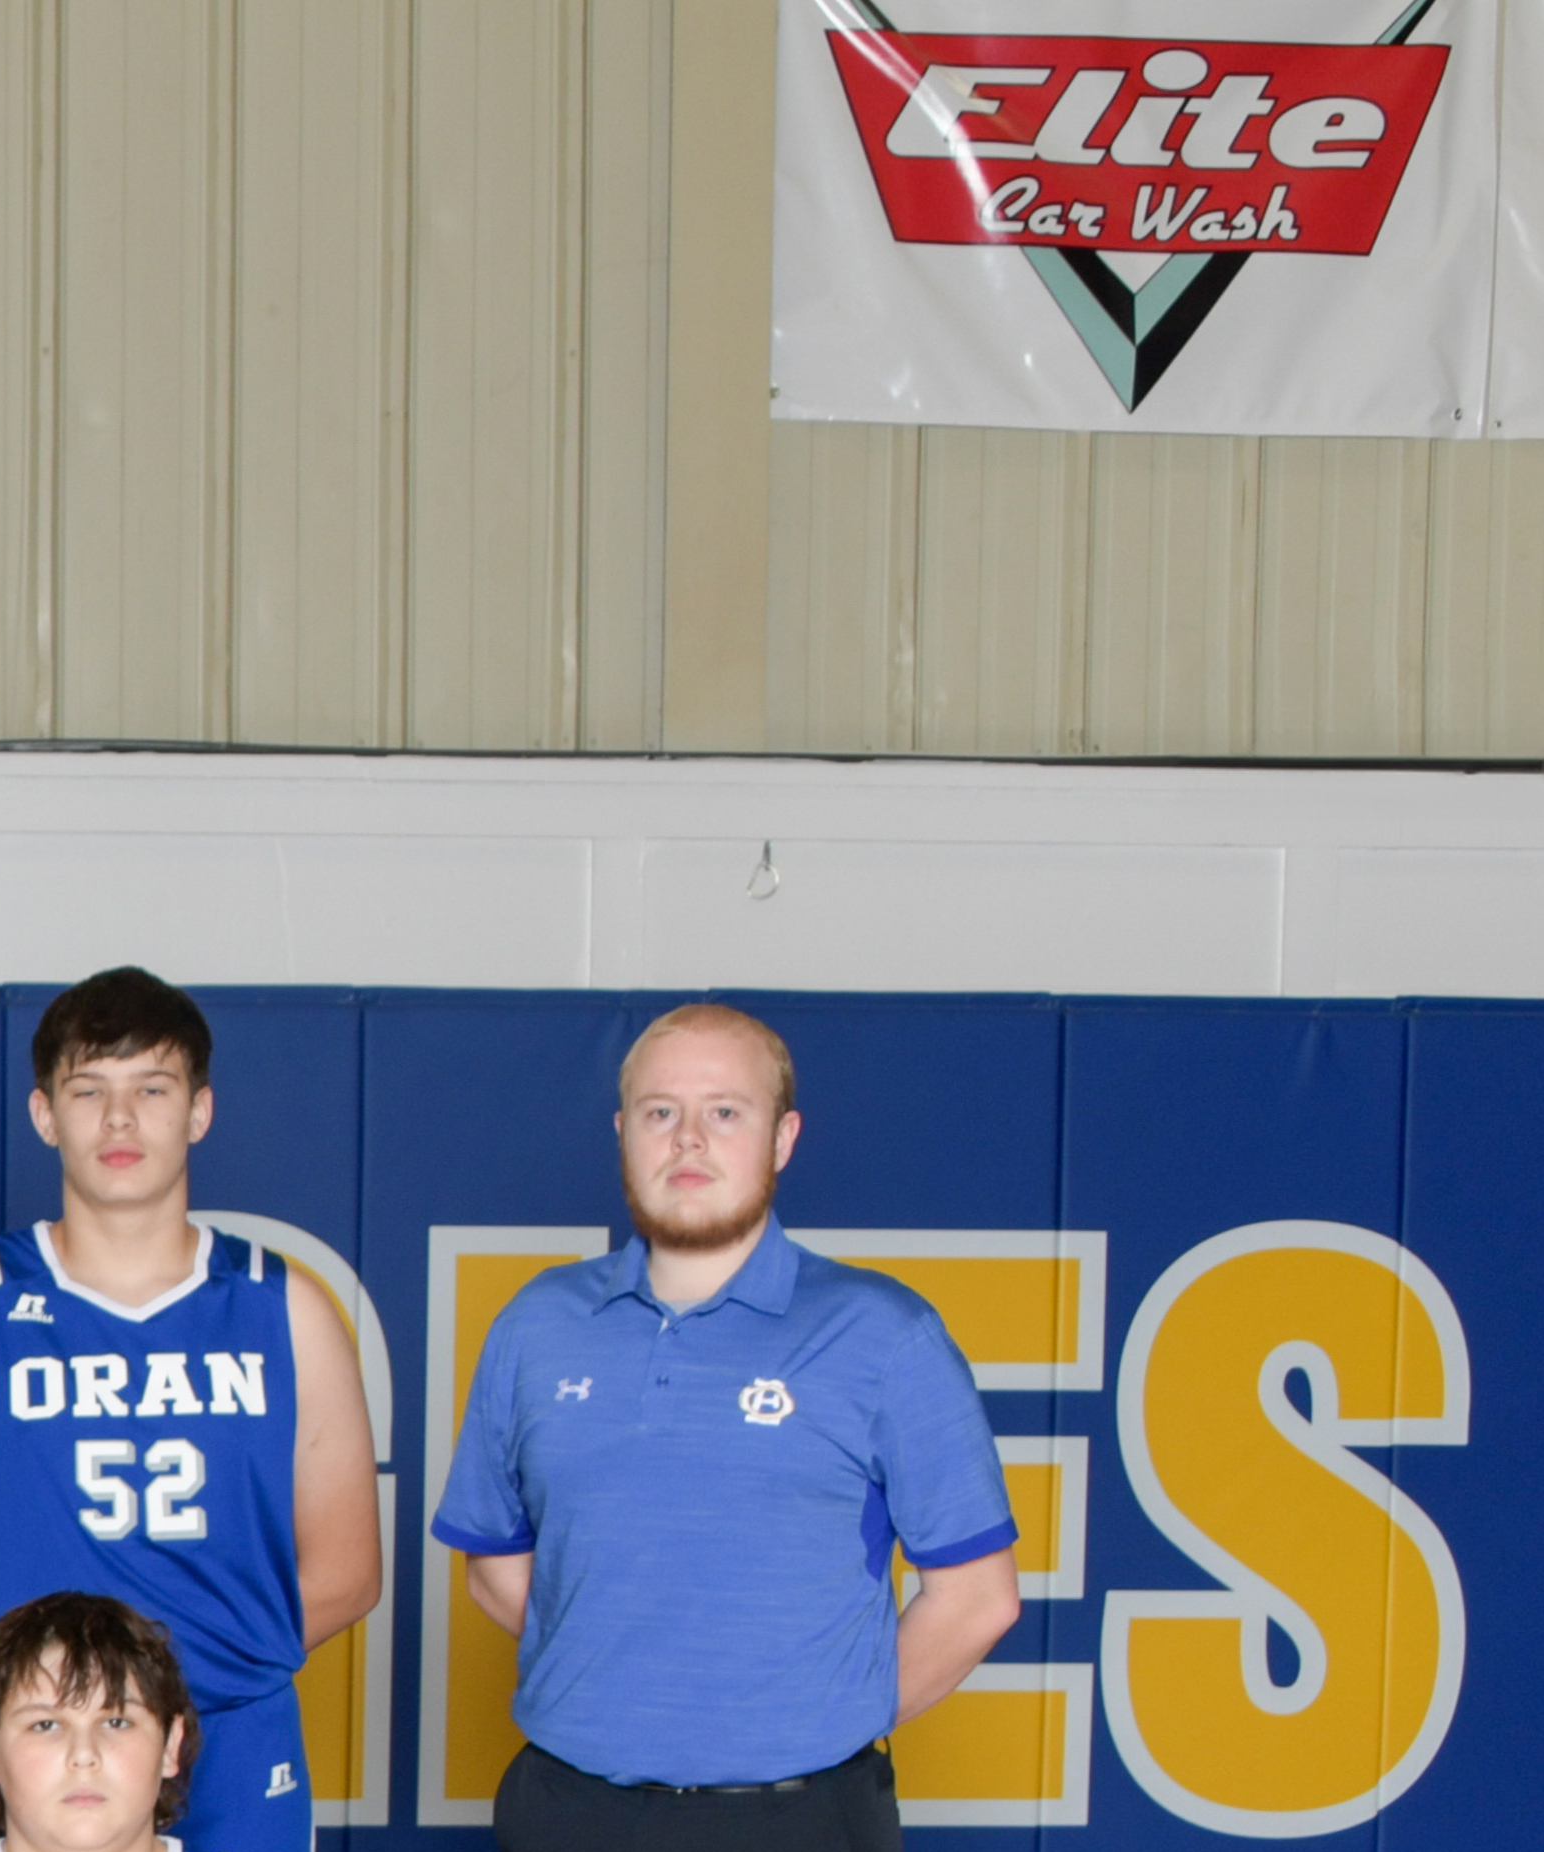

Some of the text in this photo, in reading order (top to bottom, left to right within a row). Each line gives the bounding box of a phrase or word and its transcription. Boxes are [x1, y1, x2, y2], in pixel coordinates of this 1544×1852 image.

[885, 48, 1388, 170] Elite
[979, 176, 1300, 242] Car Wash
[9, 1351, 267, 1421] ORAN
[75, 1437, 208, 1541] 52
